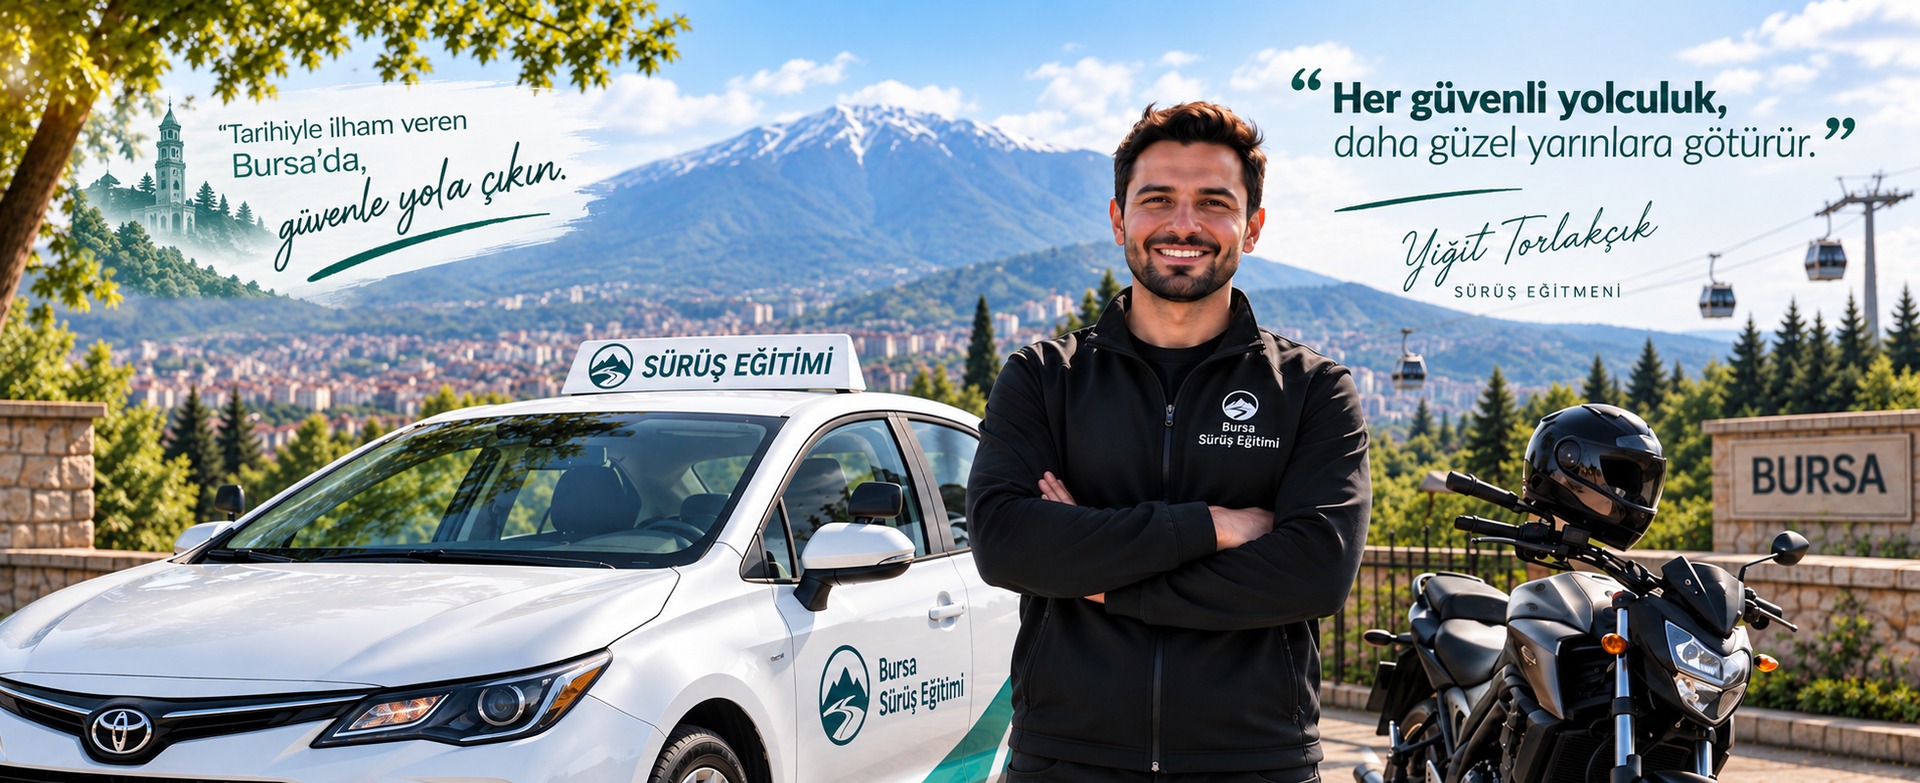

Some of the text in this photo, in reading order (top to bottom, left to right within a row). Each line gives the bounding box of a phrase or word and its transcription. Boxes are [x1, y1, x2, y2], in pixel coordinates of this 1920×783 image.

[641, 345, 835, 383] SÜRÜŞ EĞİTİMİ
[1198, 434, 1280, 449] Sürüş Eğitimi
[1222, 421, 1256, 433] Bursa
[1752, 453, 1887, 495] BURSA
[879, 657, 917, 683] Bursa
[879, 672, 964, 716] Sürüş Eğitimi
